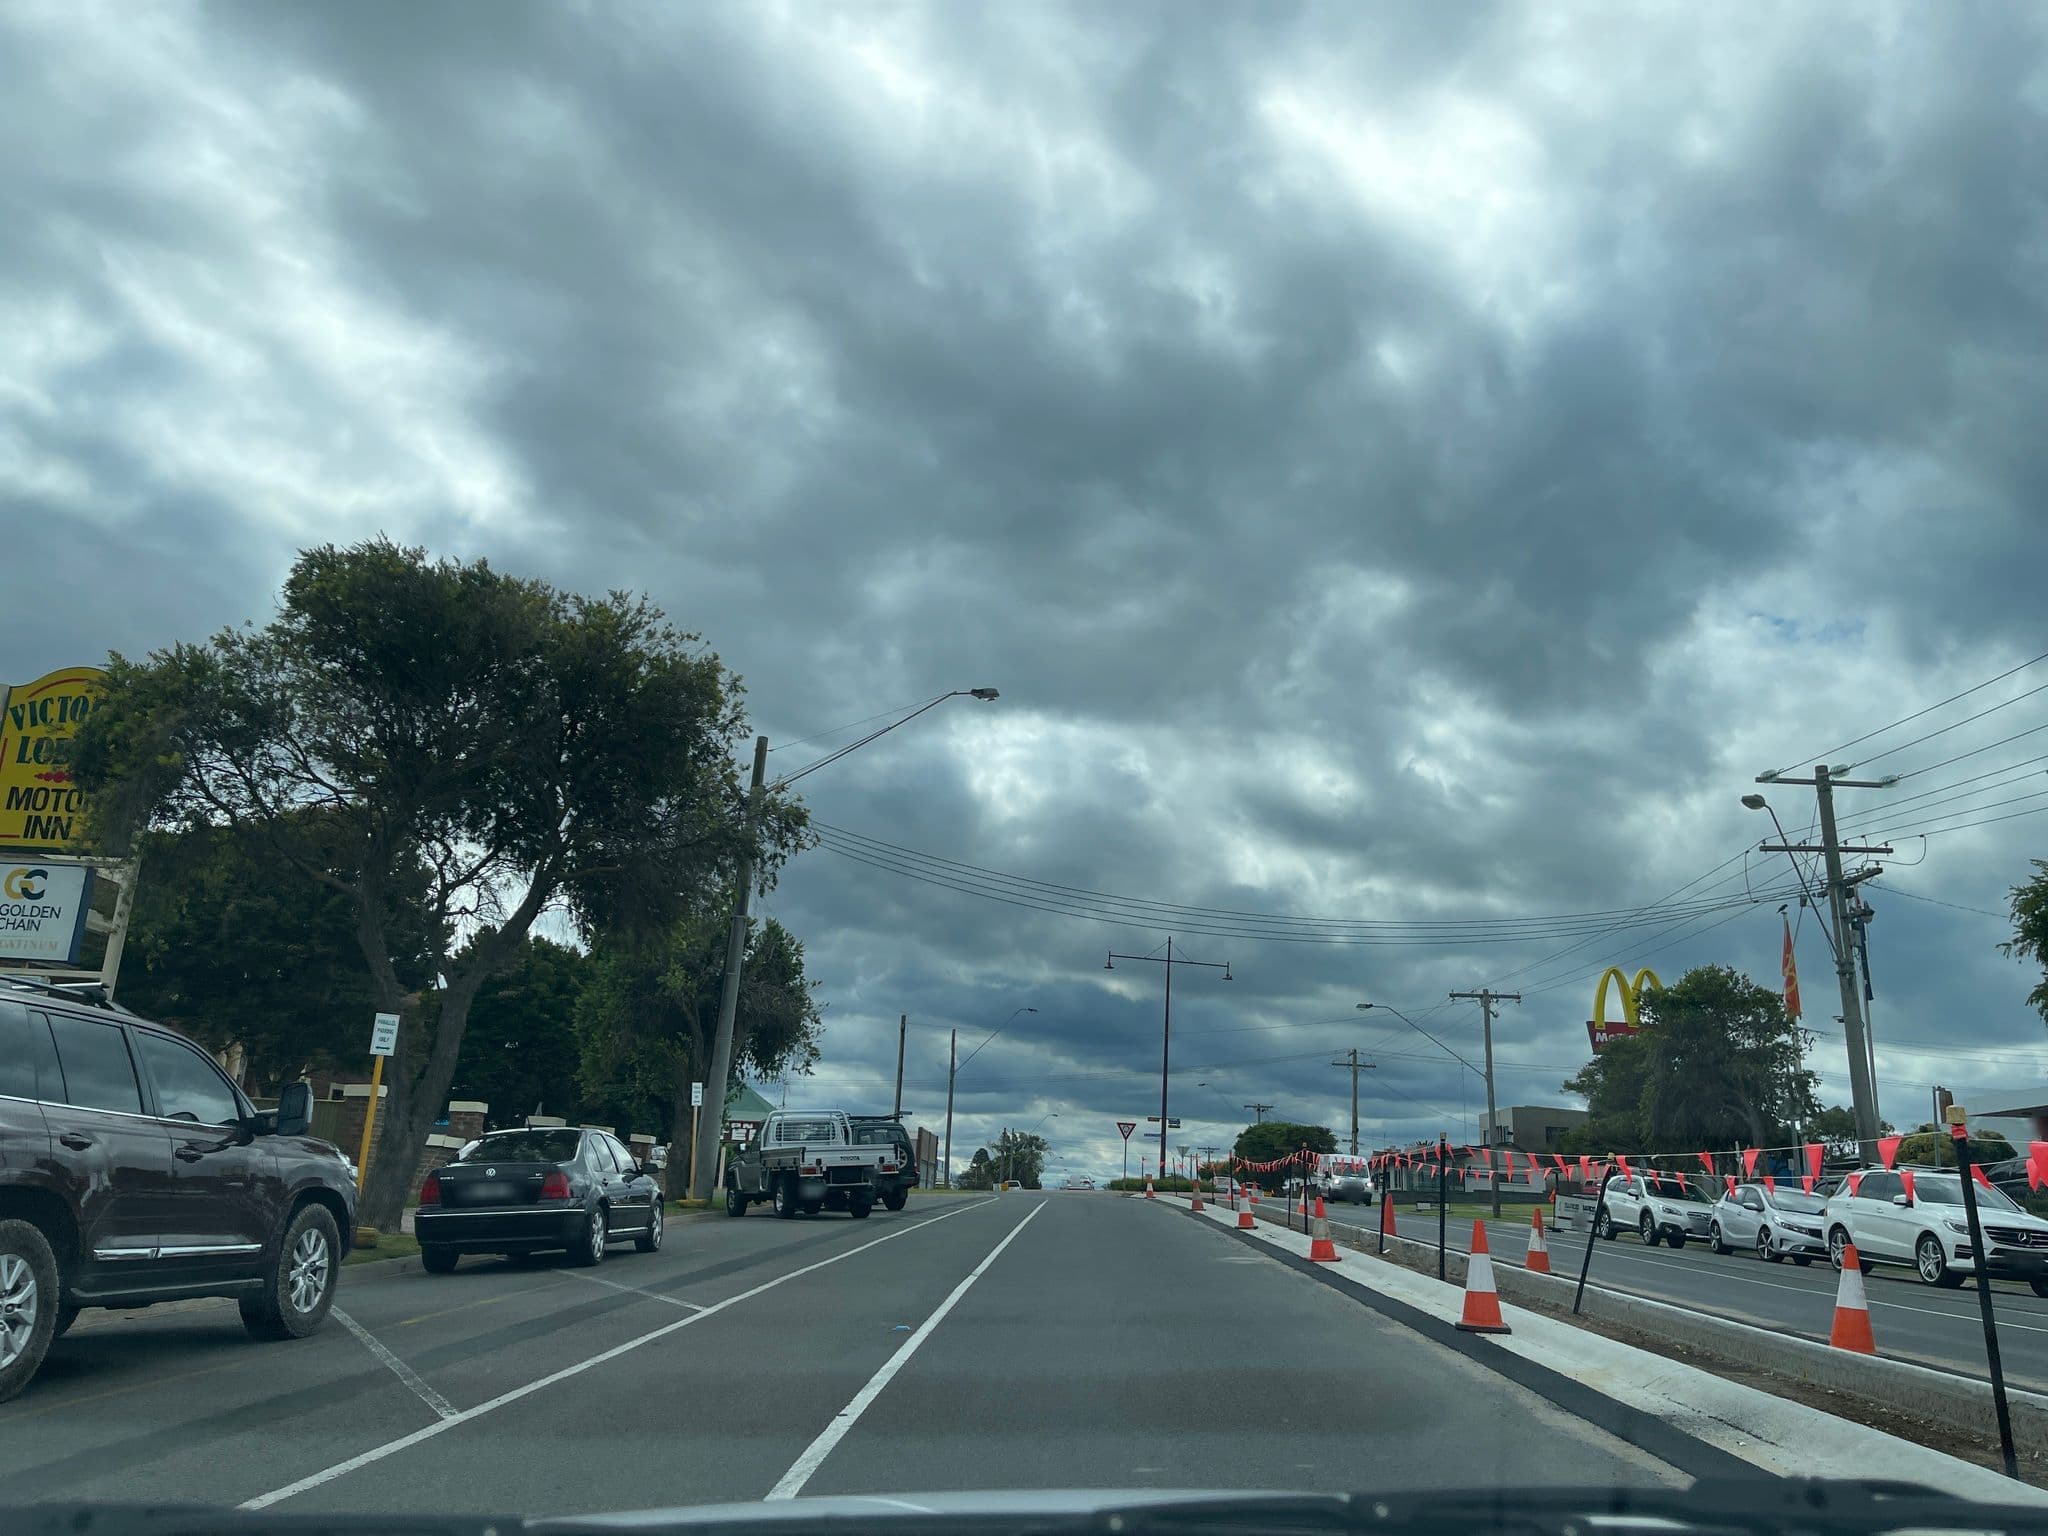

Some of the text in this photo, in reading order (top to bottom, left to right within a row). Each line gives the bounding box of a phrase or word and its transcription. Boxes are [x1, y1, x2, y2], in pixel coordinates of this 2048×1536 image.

[6, 786, 84, 813] MOTO
[23, 815, 73, 840] INN
[0, 903, 61, 919] GOLDEN
[0, 938, 58, 952] ATINUM
